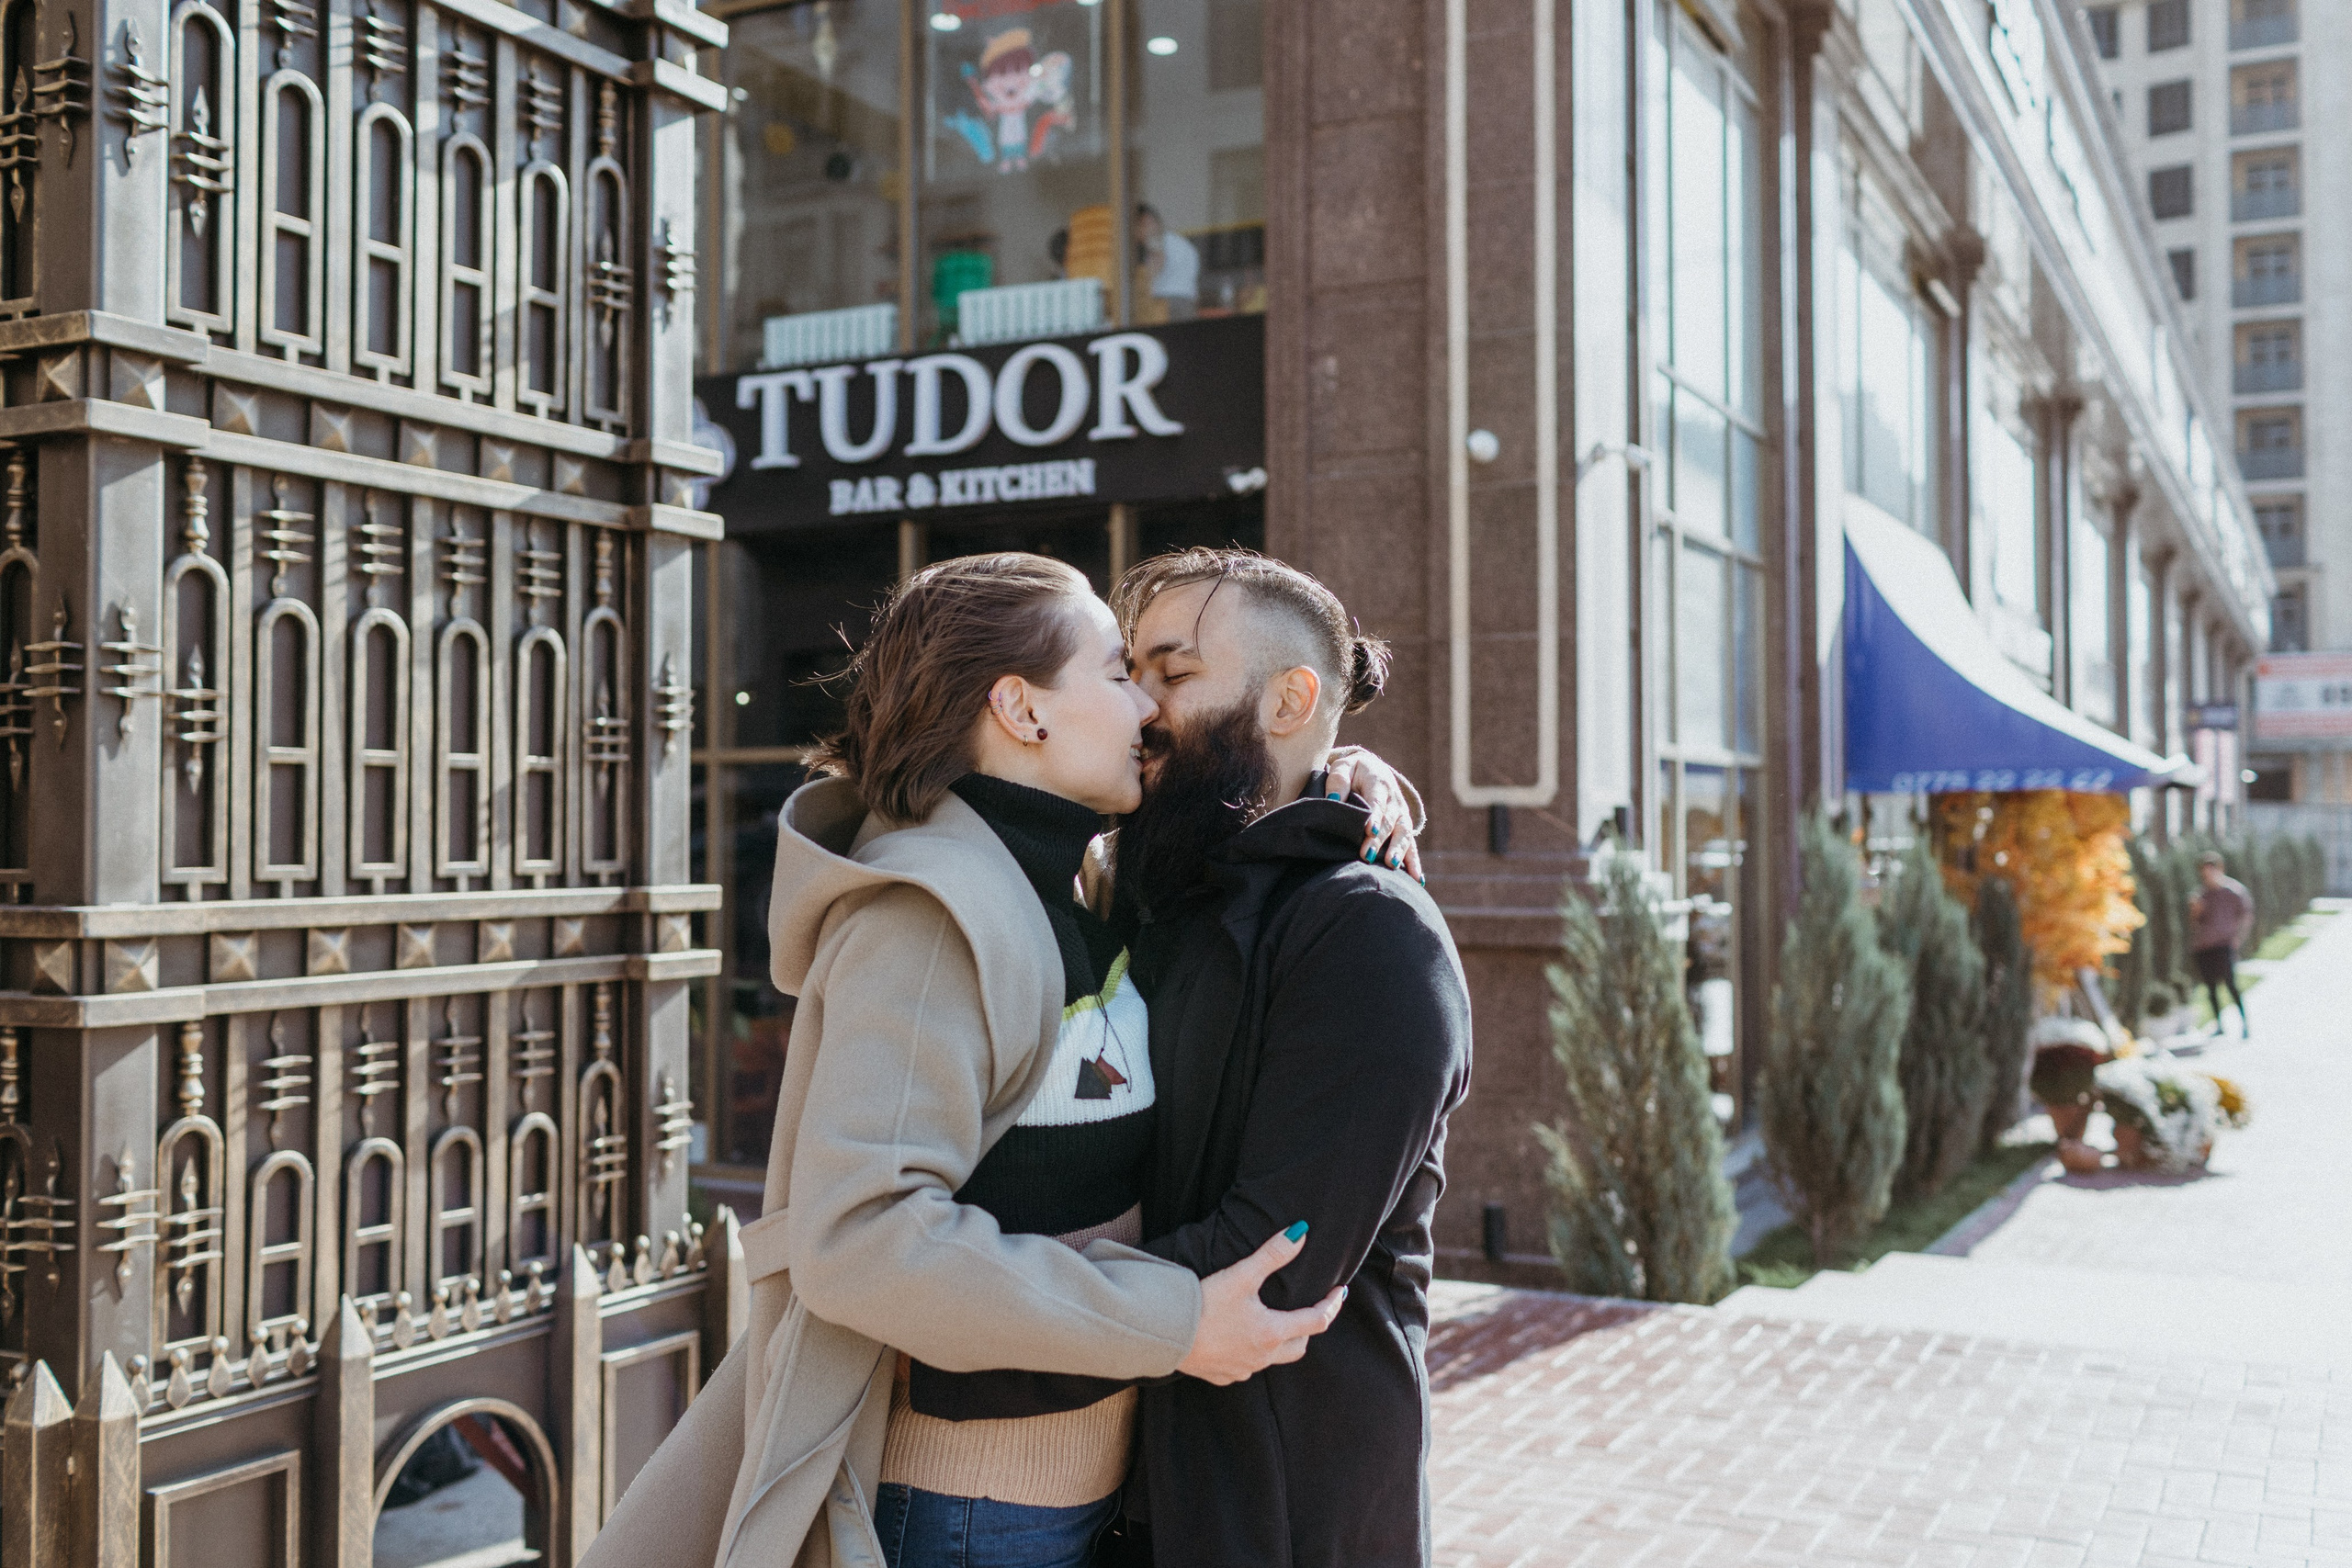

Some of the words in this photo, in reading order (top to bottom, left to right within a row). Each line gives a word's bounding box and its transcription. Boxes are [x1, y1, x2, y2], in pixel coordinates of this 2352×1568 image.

[736, 333, 1185, 469] TUDOR
[829, 477, 903, 515] BAR
[906, 470, 937, 509] &
[938, 458, 1098, 507] KITCHEN
